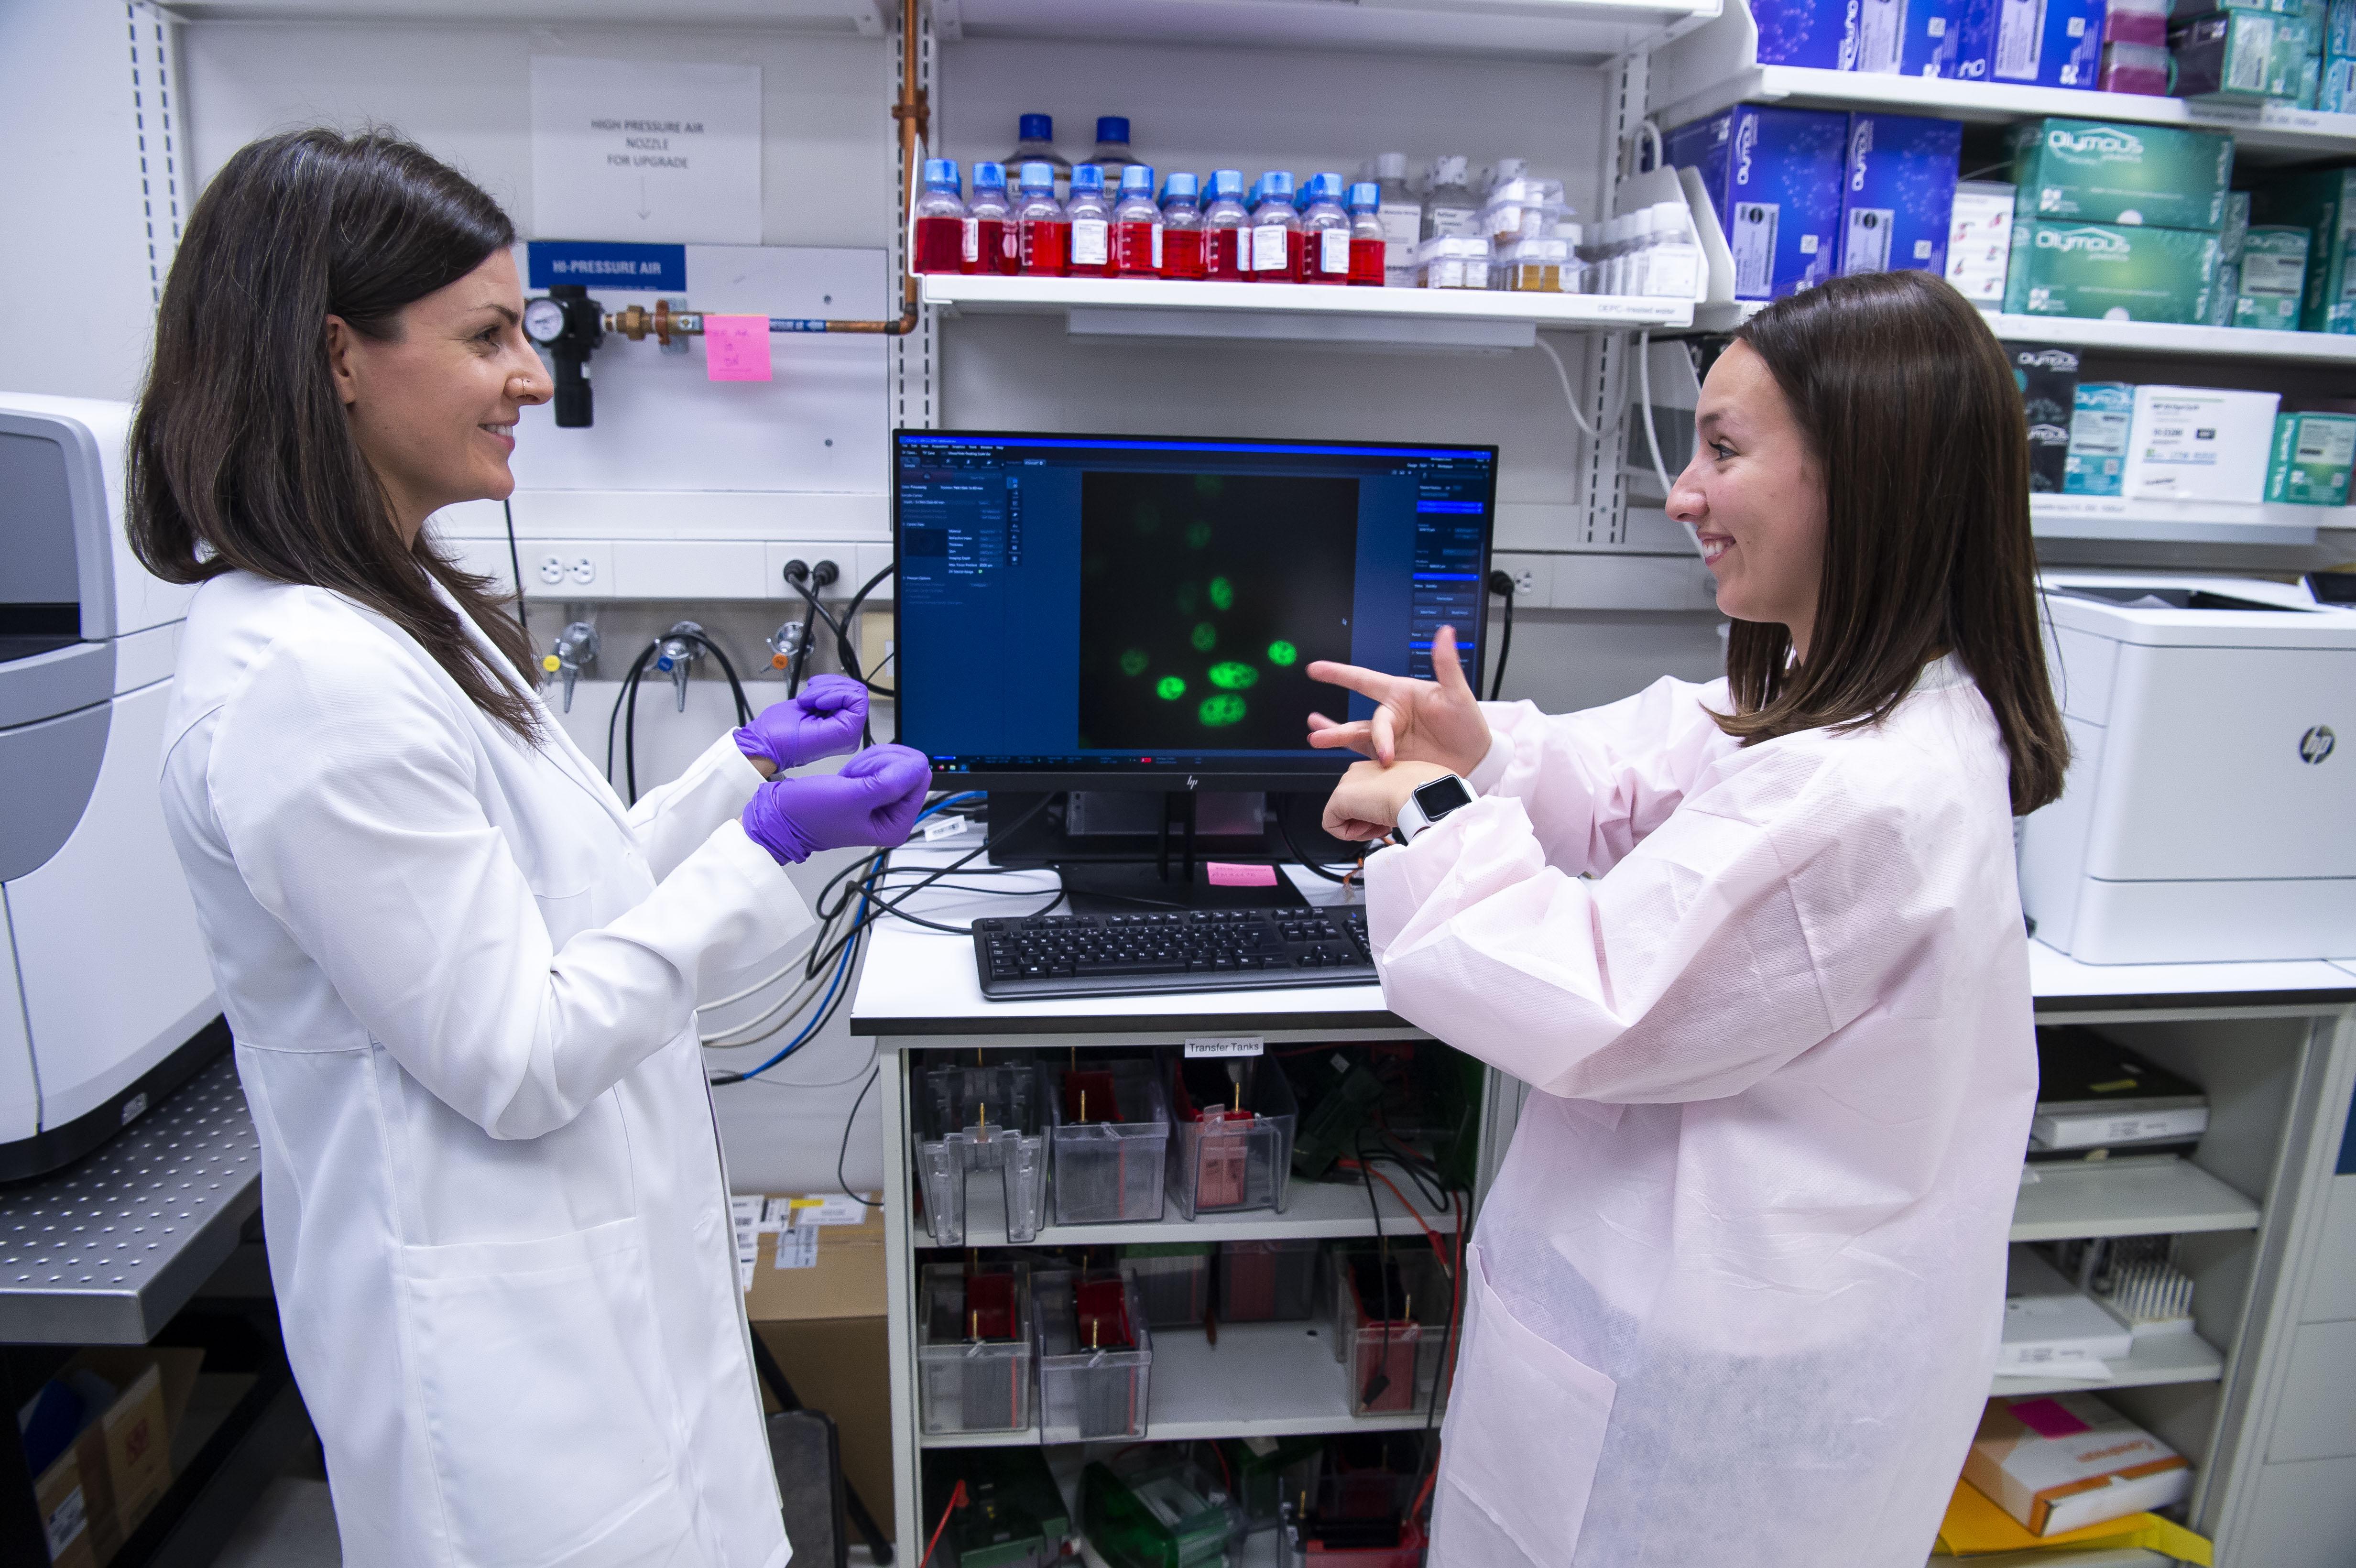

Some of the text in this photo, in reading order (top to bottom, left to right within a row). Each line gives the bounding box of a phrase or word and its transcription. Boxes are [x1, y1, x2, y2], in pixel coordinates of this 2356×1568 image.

[591, 119, 704, 133] HIGH PRESSURE AIR
[625, 137, 668, 150] NOZZLE
[607, 154, 688, 168] FOR UPGRADE
[552, 260, 661, 275] HI-PRESSURE AIR
[2299, 724, 2336, 765] hp
[1187, 775, 1199, 790] hp
[1189, 1042, 1259, 1052] Transfer Tanks
